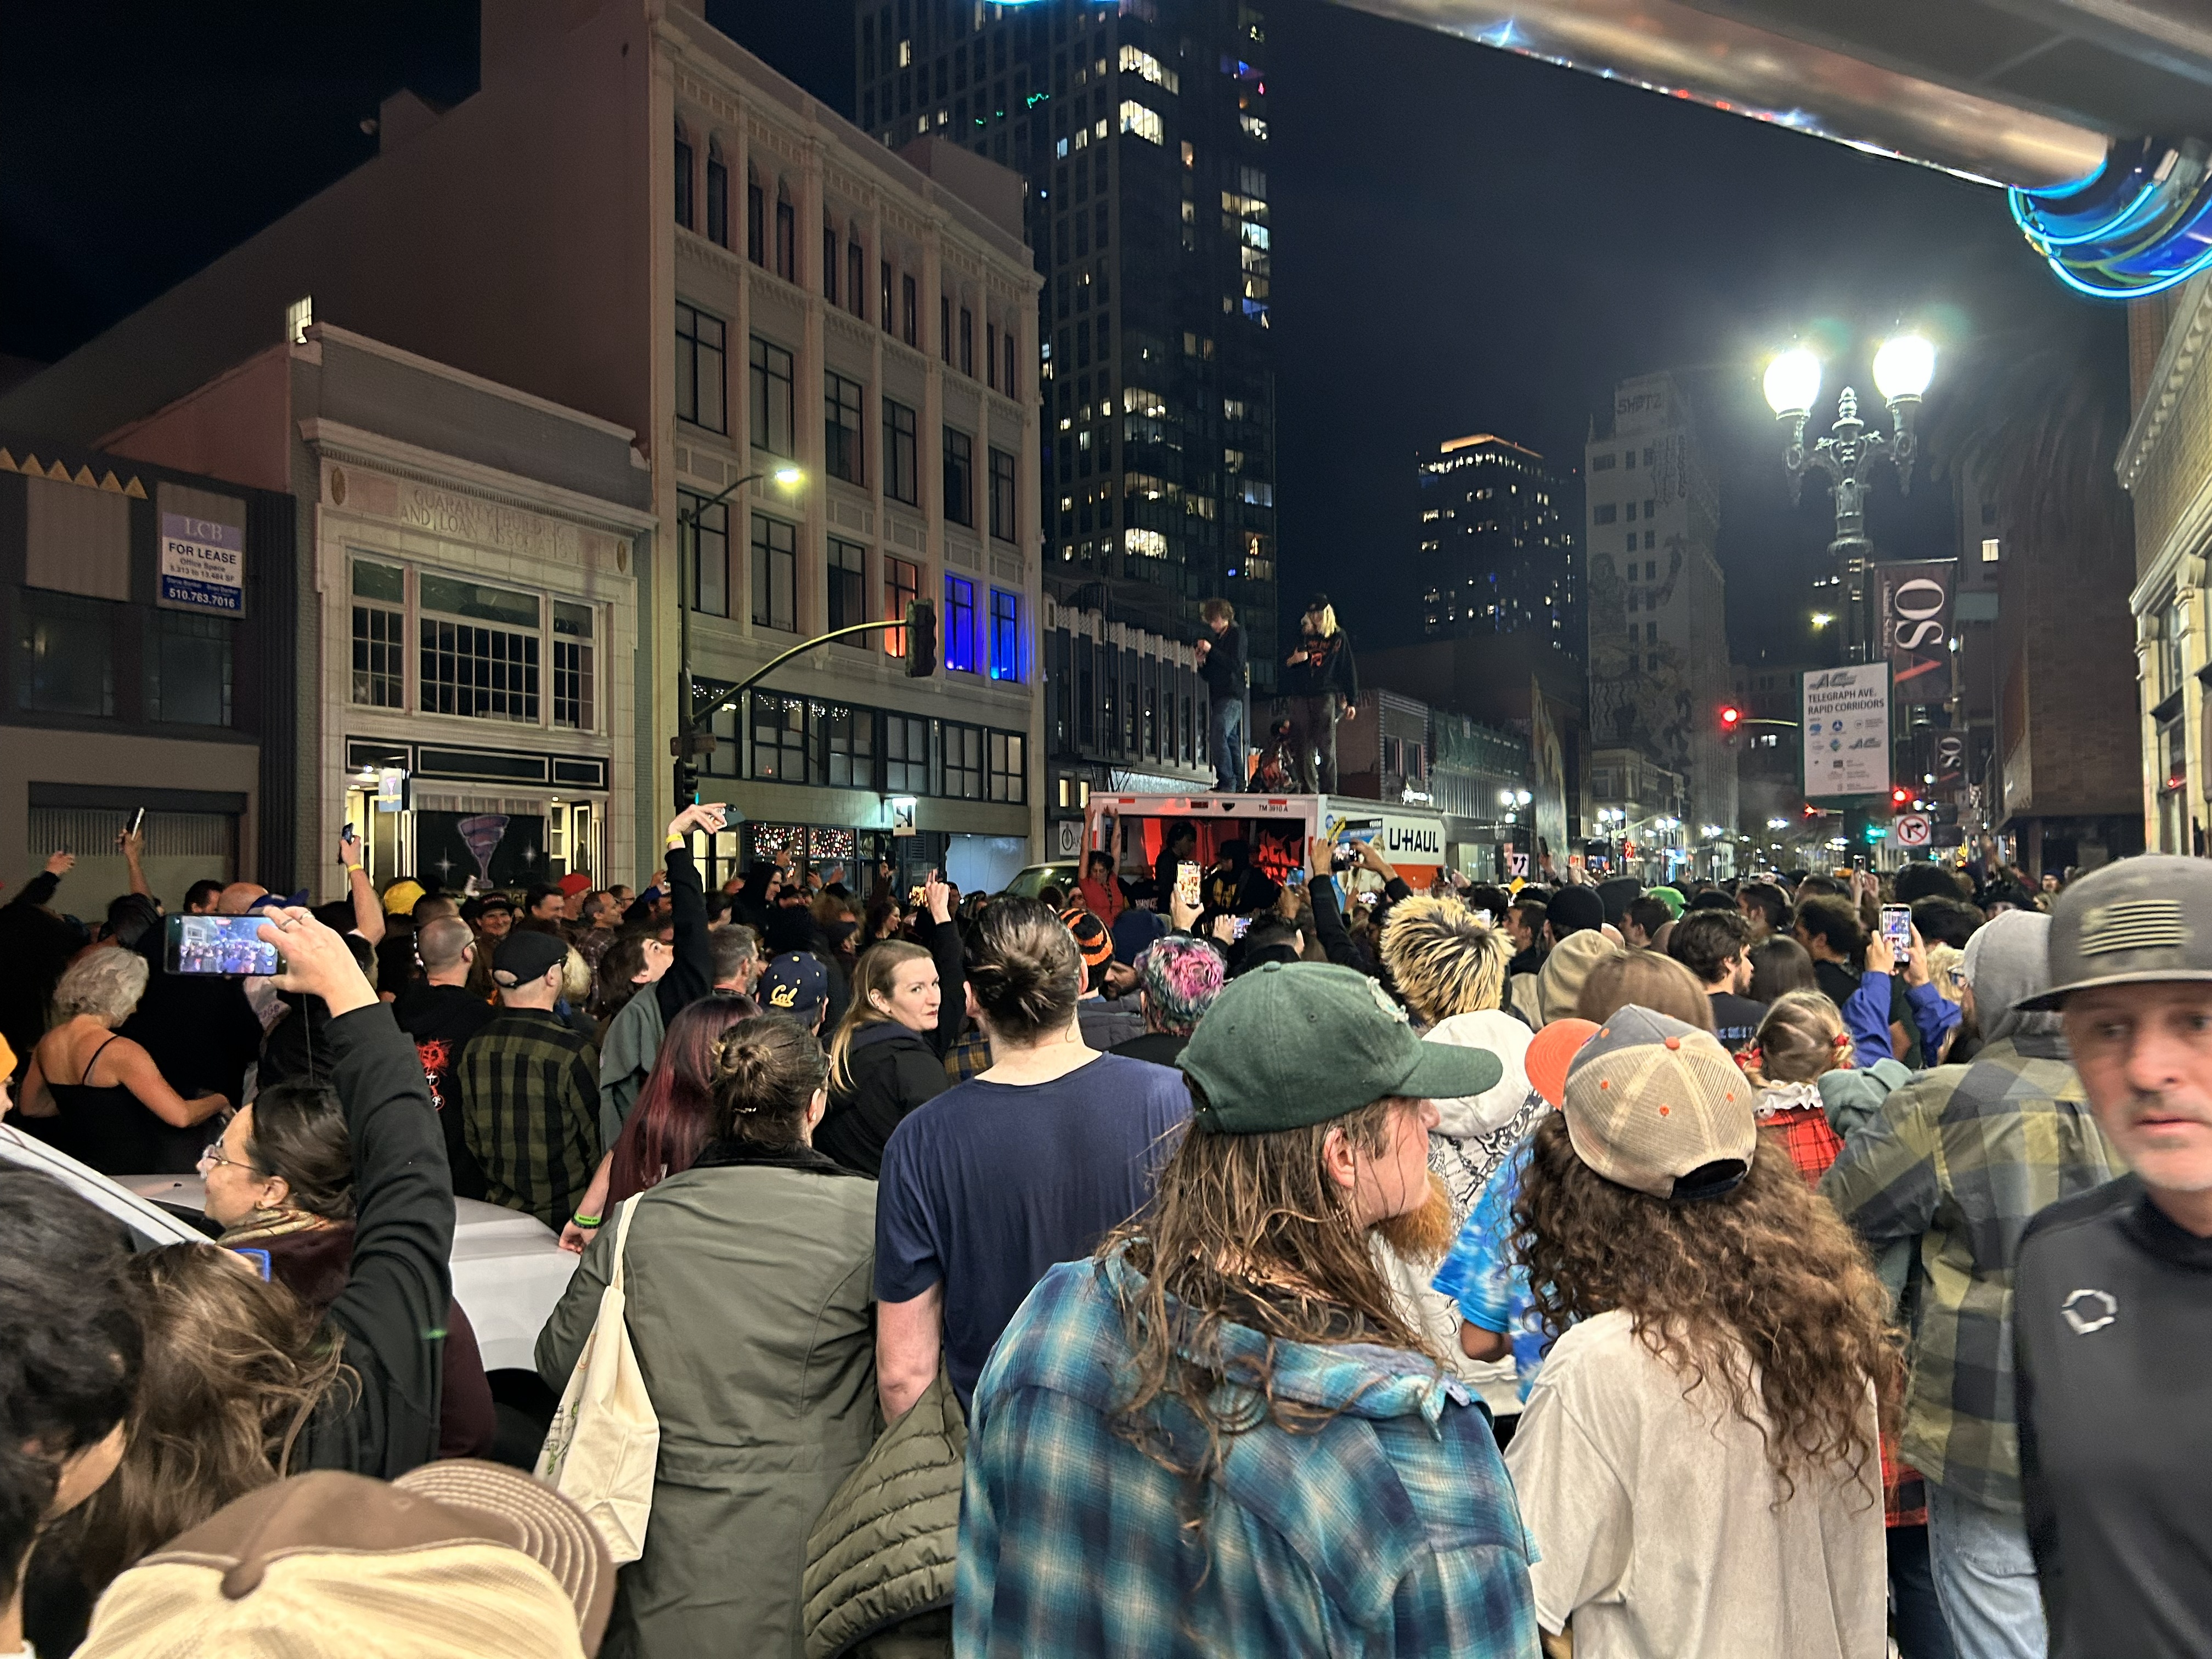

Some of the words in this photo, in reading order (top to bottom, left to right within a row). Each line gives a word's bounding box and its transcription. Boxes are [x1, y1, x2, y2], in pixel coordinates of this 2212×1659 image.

[414, 488, 494, 522] GUARANTY
[184, 518, 223, 541] LCB
[400, 504, 431, 526] AND
[440, 511, 477, 539] LOAN
[169, 543, 194, 557] FOR
[198, 548, 236, 565] LEASE
[169, 588, 235, 608] 510.763.7016
[1808, 690, 1856, 703] TELEGRAPH
[1808, 704, 1833, 715] RAPID
[1835, 698, 1884, 712] CORRIDORS
[1389, 827, 1439, 853] U-HAUL
[769, 984, 798, 1008] Cal
